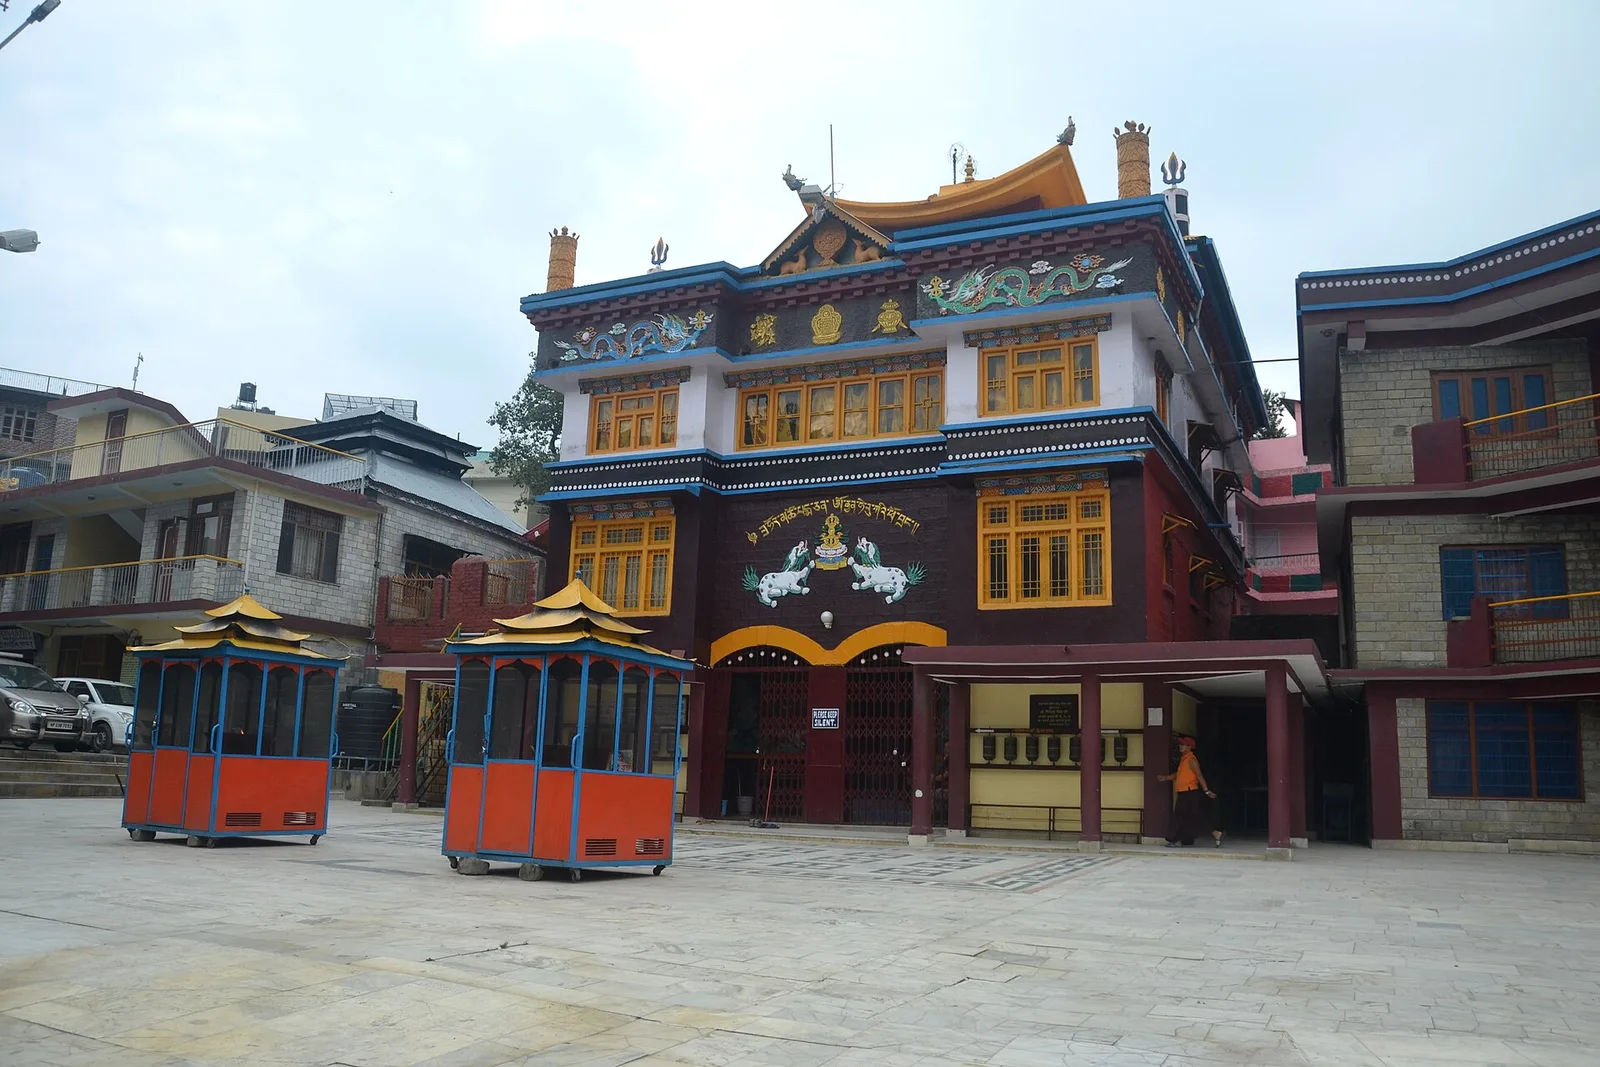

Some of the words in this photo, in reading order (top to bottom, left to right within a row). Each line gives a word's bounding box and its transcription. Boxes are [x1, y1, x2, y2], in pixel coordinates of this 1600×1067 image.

[813, 711, 827, 719] PLEASE
[827, 711, 838, 719] KEEP
[814, 719, 837, 727] SILENT.
